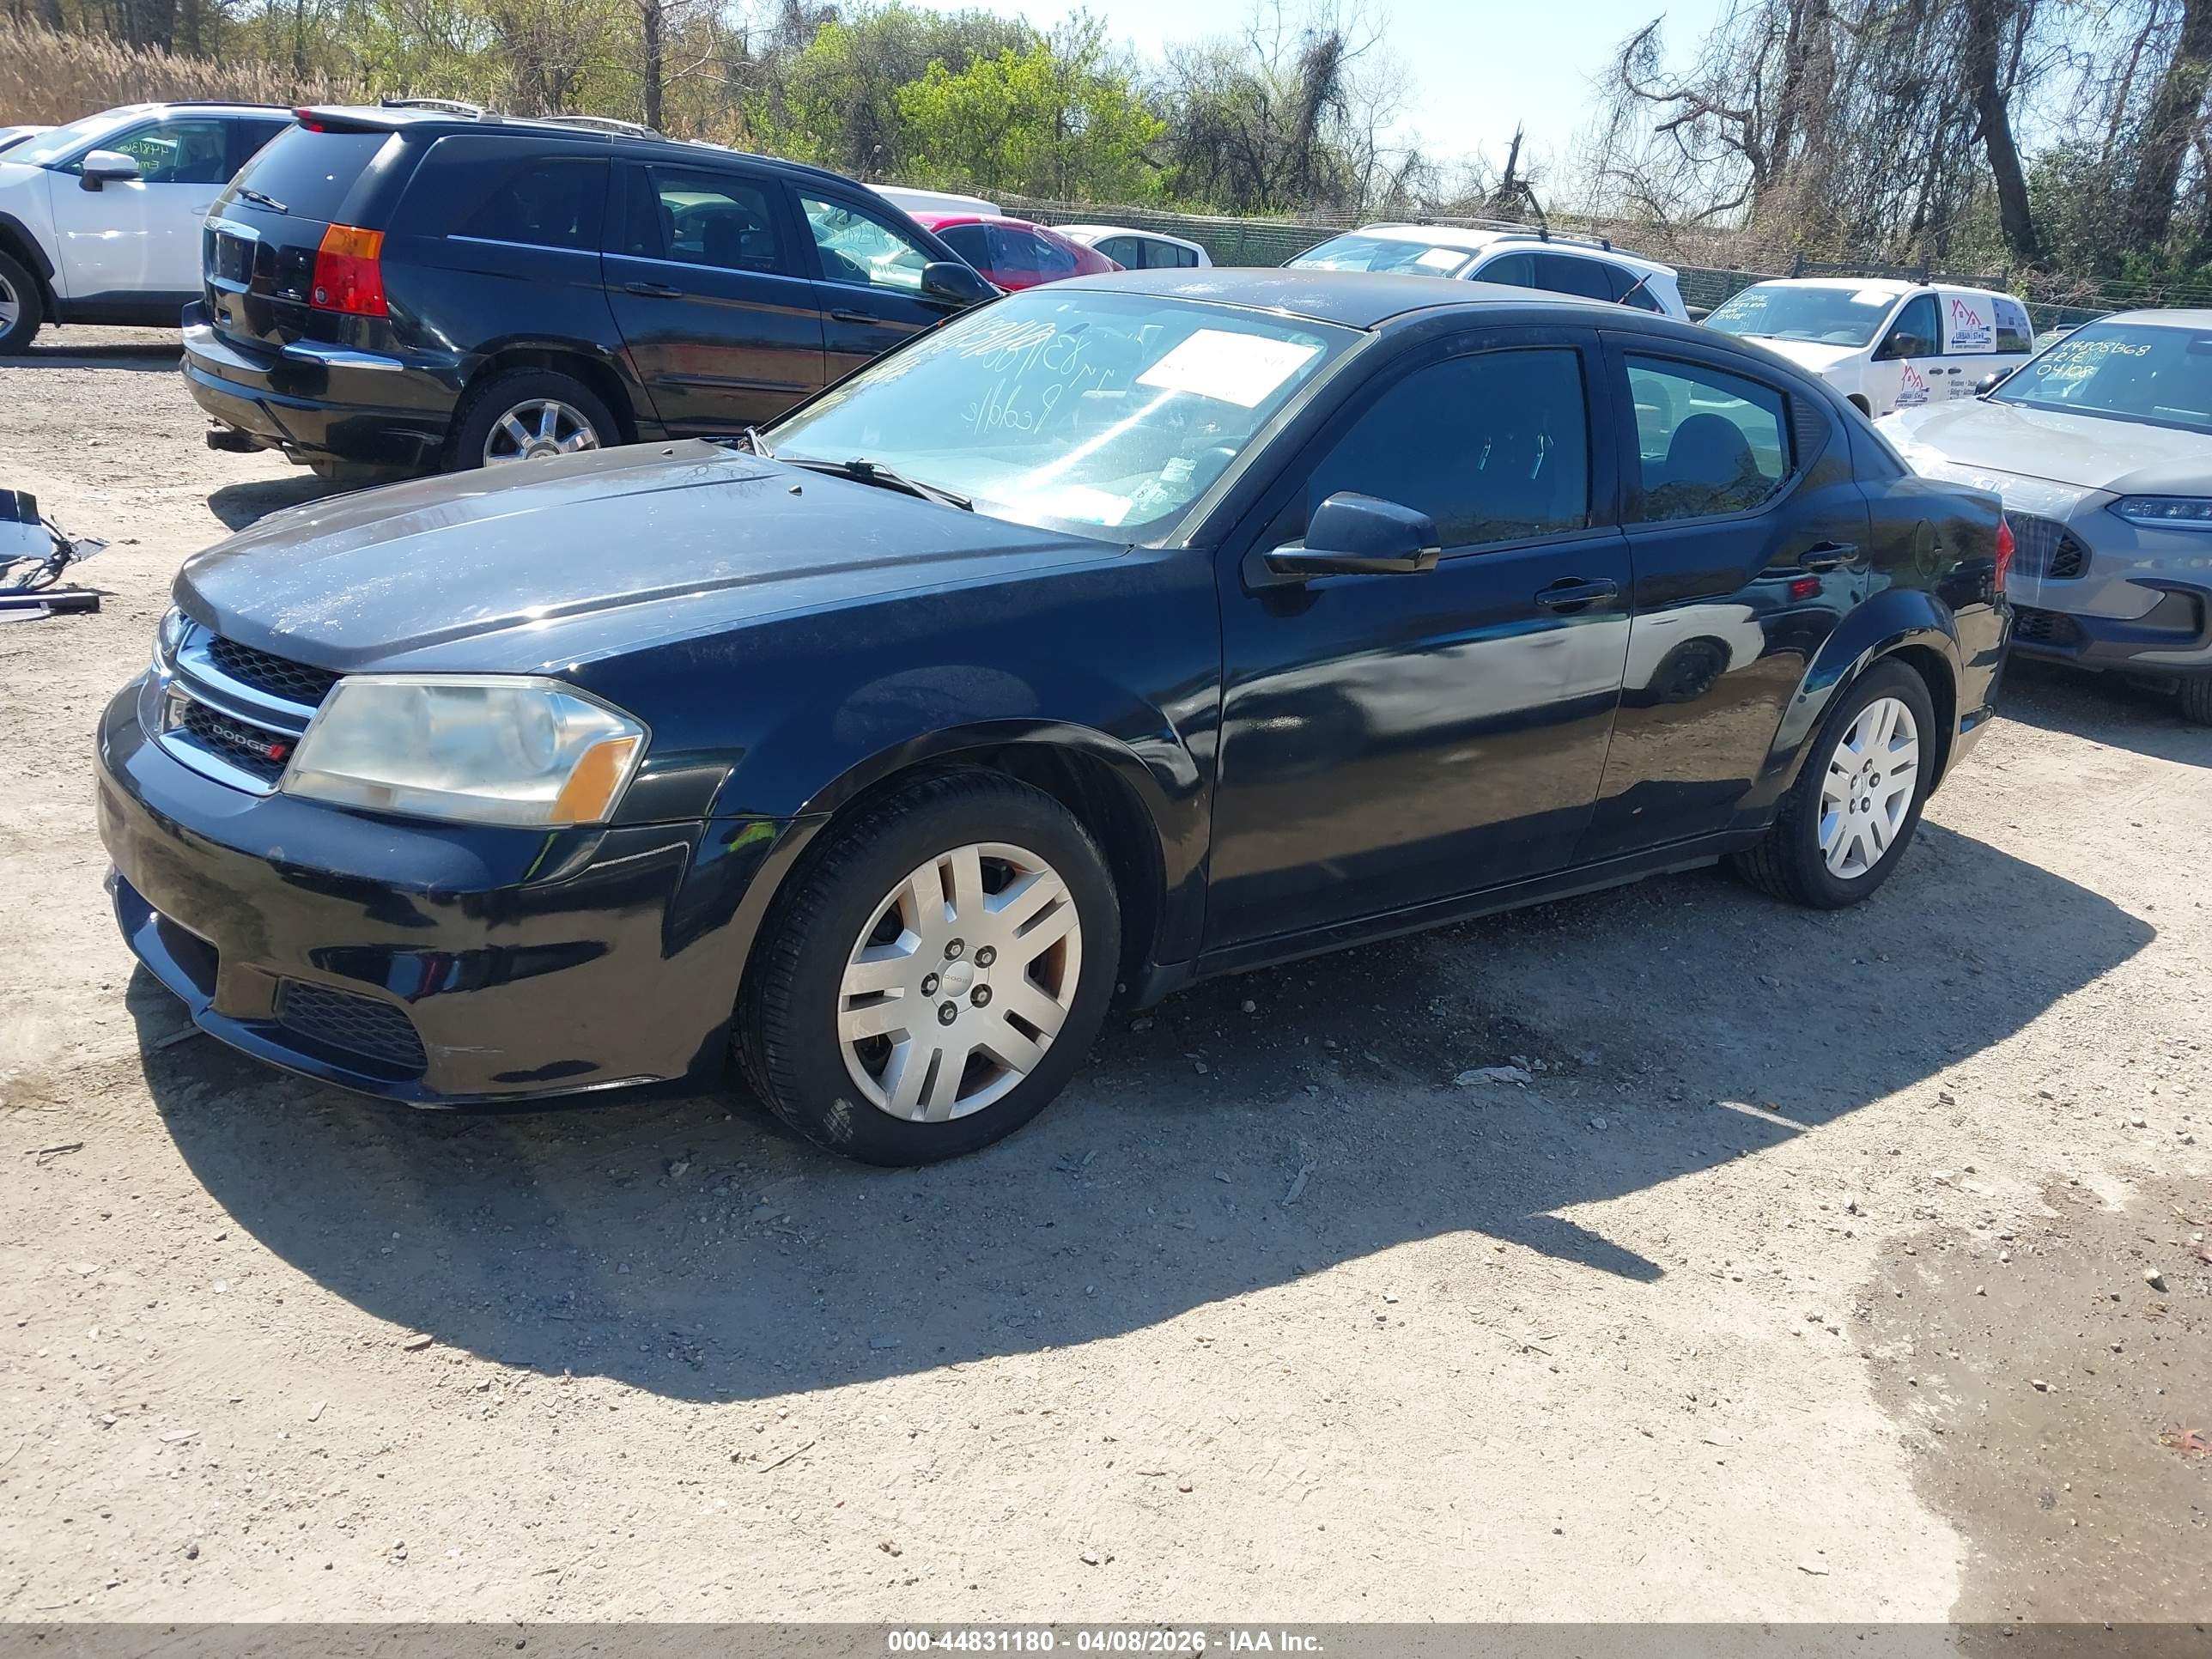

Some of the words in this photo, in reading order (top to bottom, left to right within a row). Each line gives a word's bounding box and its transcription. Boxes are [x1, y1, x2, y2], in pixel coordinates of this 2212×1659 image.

[2038, 350, 2088, 362] ERIE
[2037, 362, 2095, 378] 04/08
[213, 724, 272, 756] DODGE
